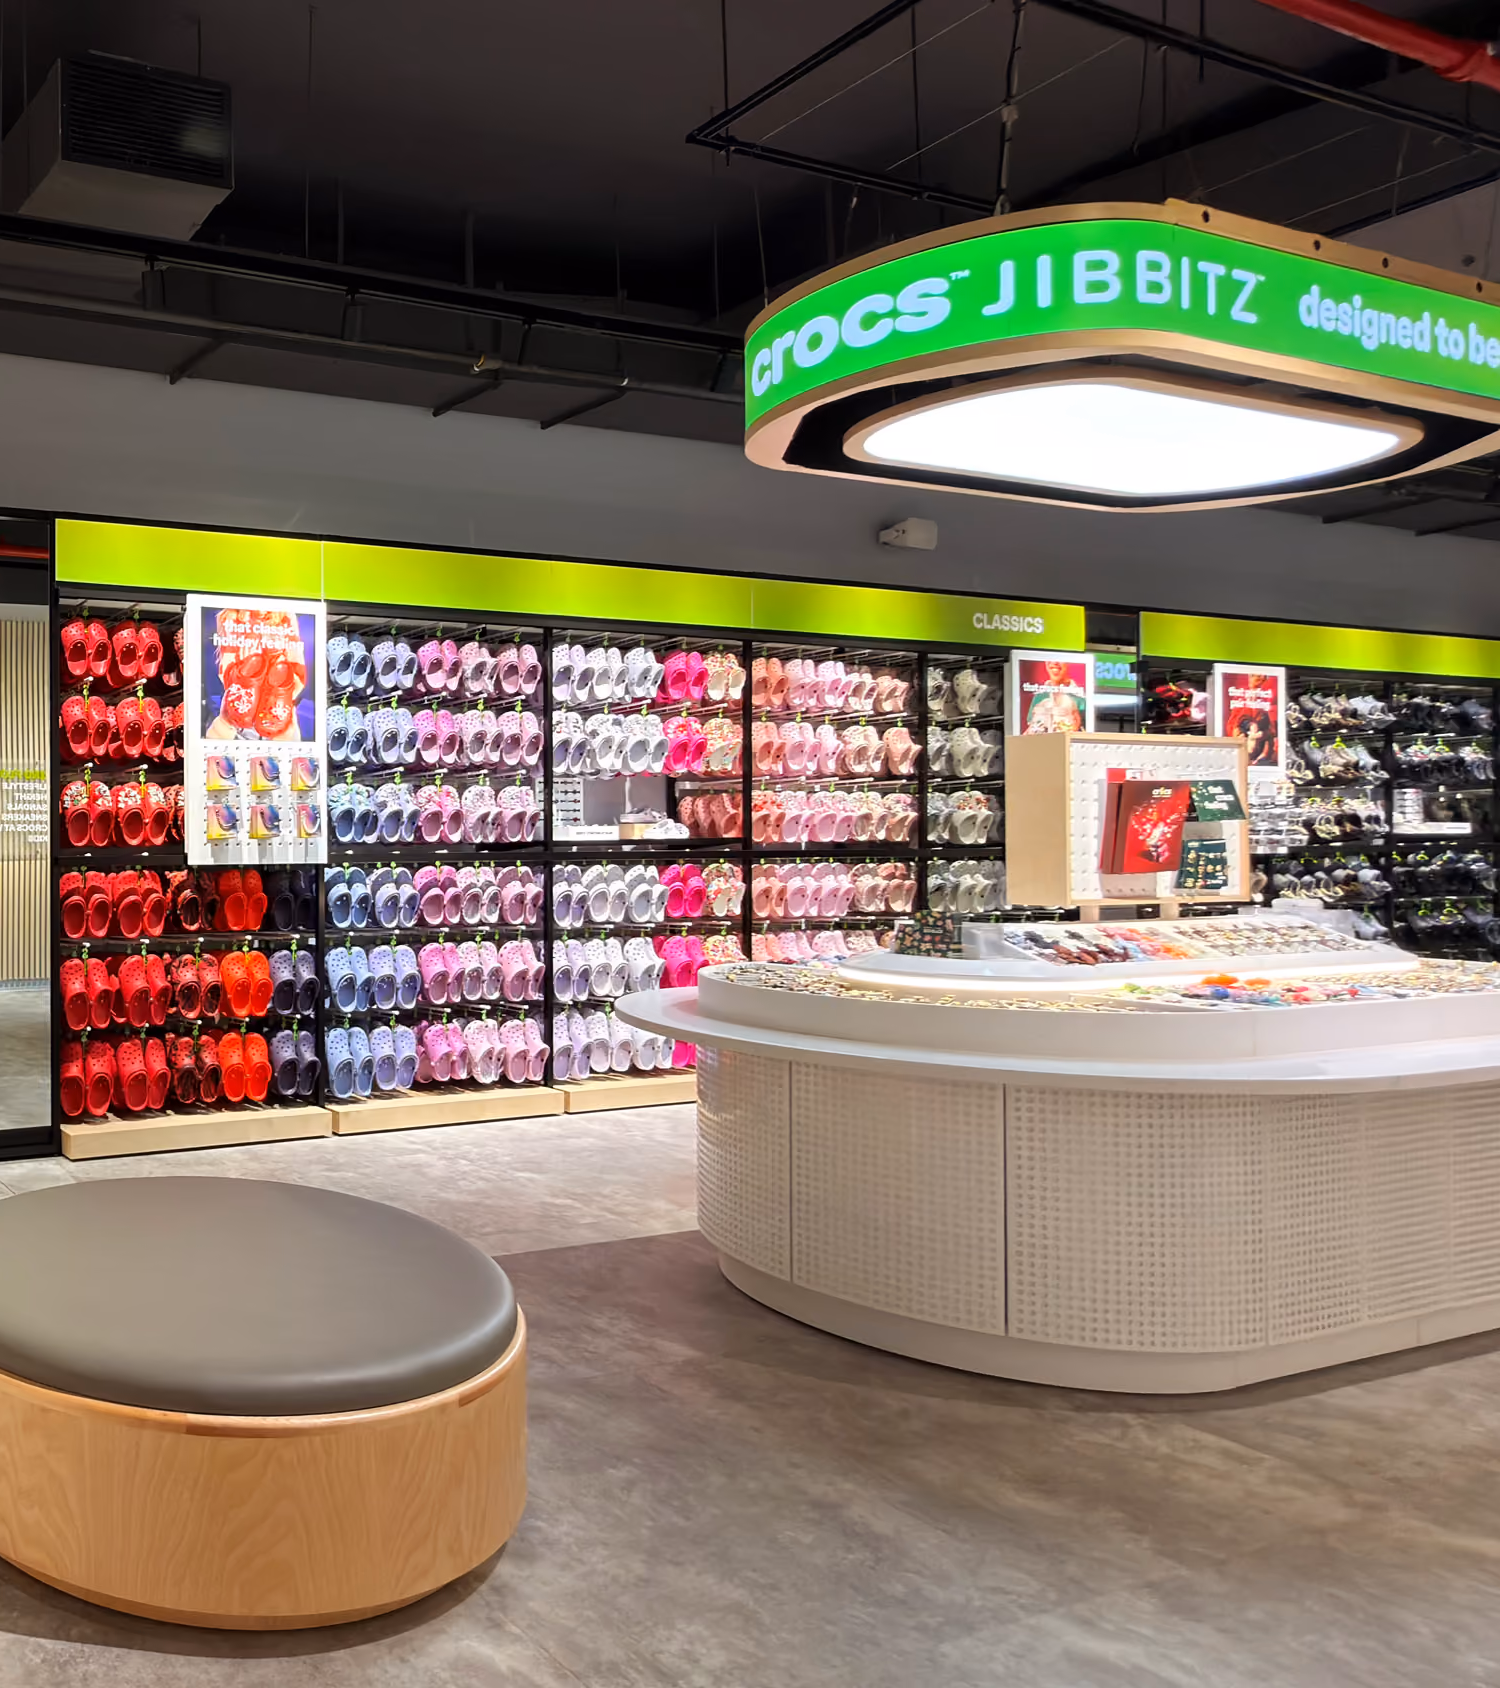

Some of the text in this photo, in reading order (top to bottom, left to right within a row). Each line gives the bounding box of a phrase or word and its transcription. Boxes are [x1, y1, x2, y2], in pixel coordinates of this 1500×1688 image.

[981, 249, 1259, 325] JIBBITZ
[1298, 284, 1431, 352] designed
[1434, 317, 1465, 361] to
[1468, 322, 1500, 368] be
[223, 620, 295, 636] that classic
[972, 612, 1044, 634] CLASSICS
[213, 633, 305, 654] holiday feeling
